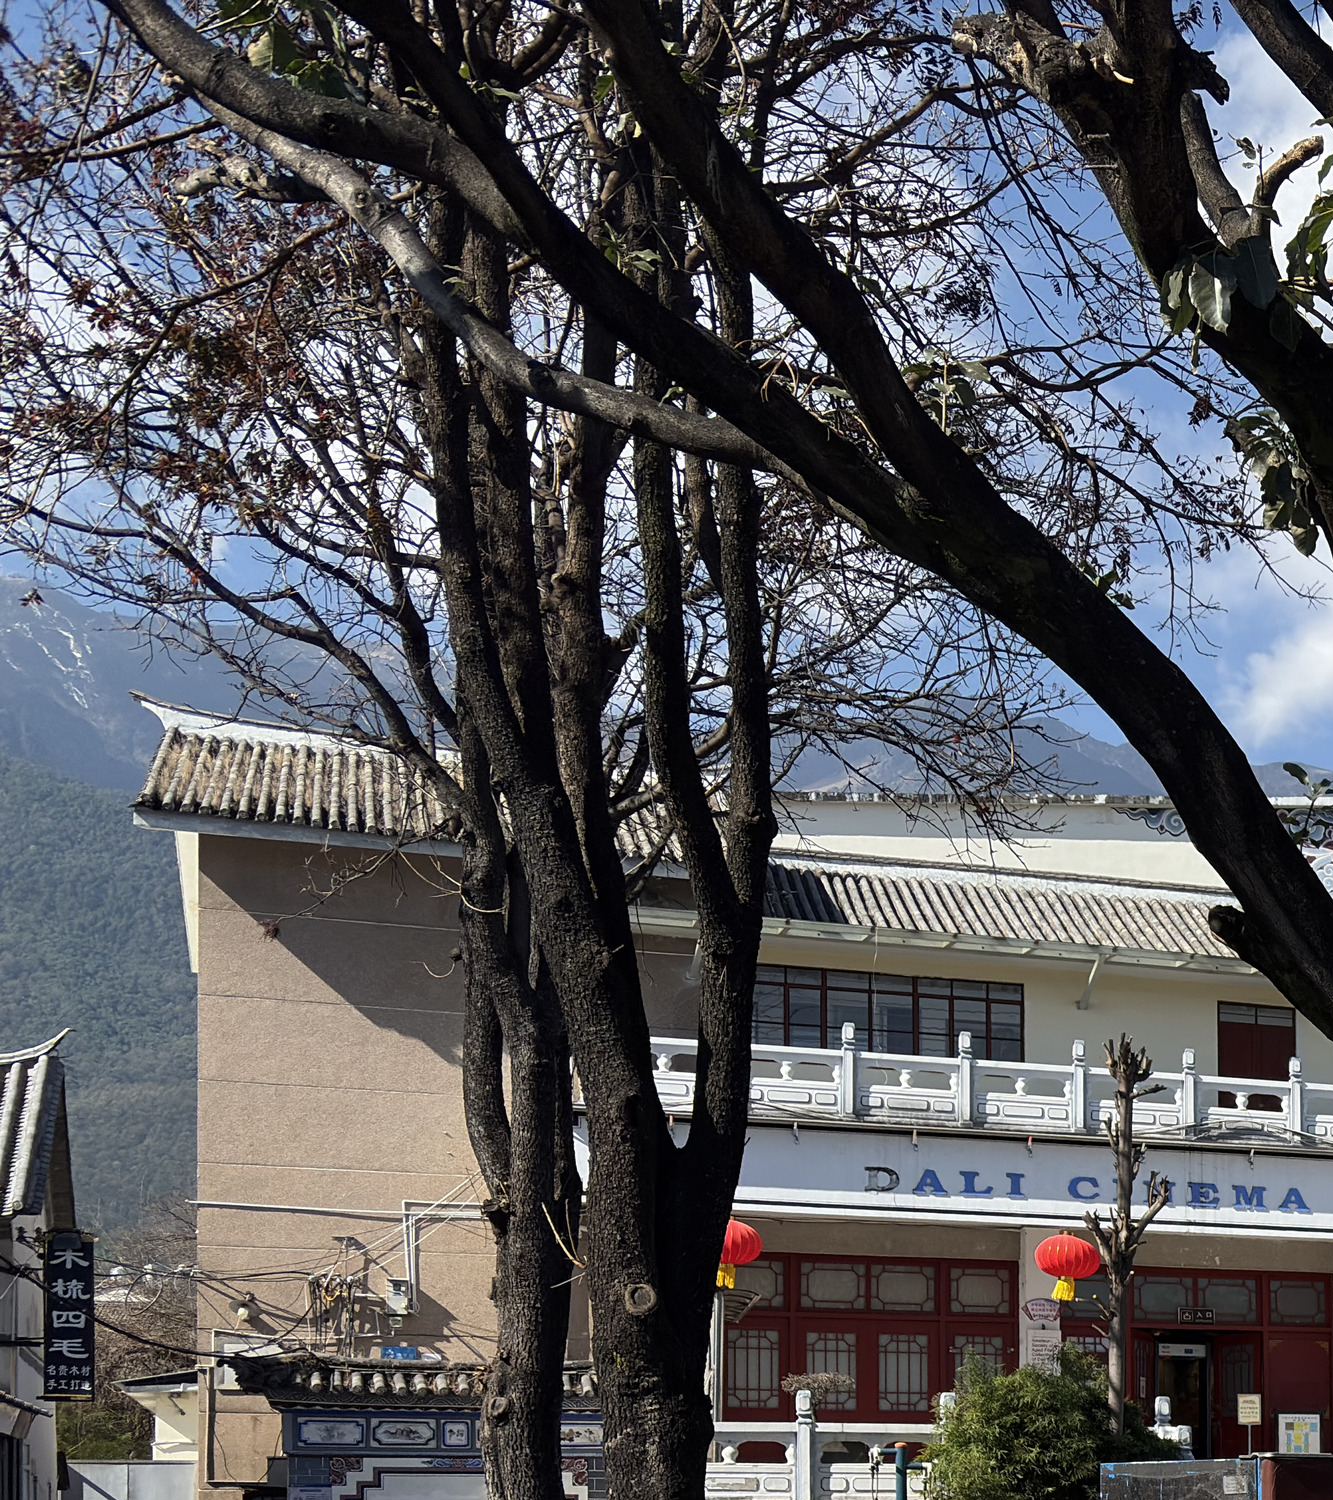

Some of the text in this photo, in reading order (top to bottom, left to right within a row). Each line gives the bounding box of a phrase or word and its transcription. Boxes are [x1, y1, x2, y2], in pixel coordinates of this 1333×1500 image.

[864, 1166, 1026, 1199] DALI
[49, 1249, 91, 1358] 木梳四毛
[46, 1364, 91, 1376] 名贵木材
[46, 1379, 92, 1391] 手工打造
